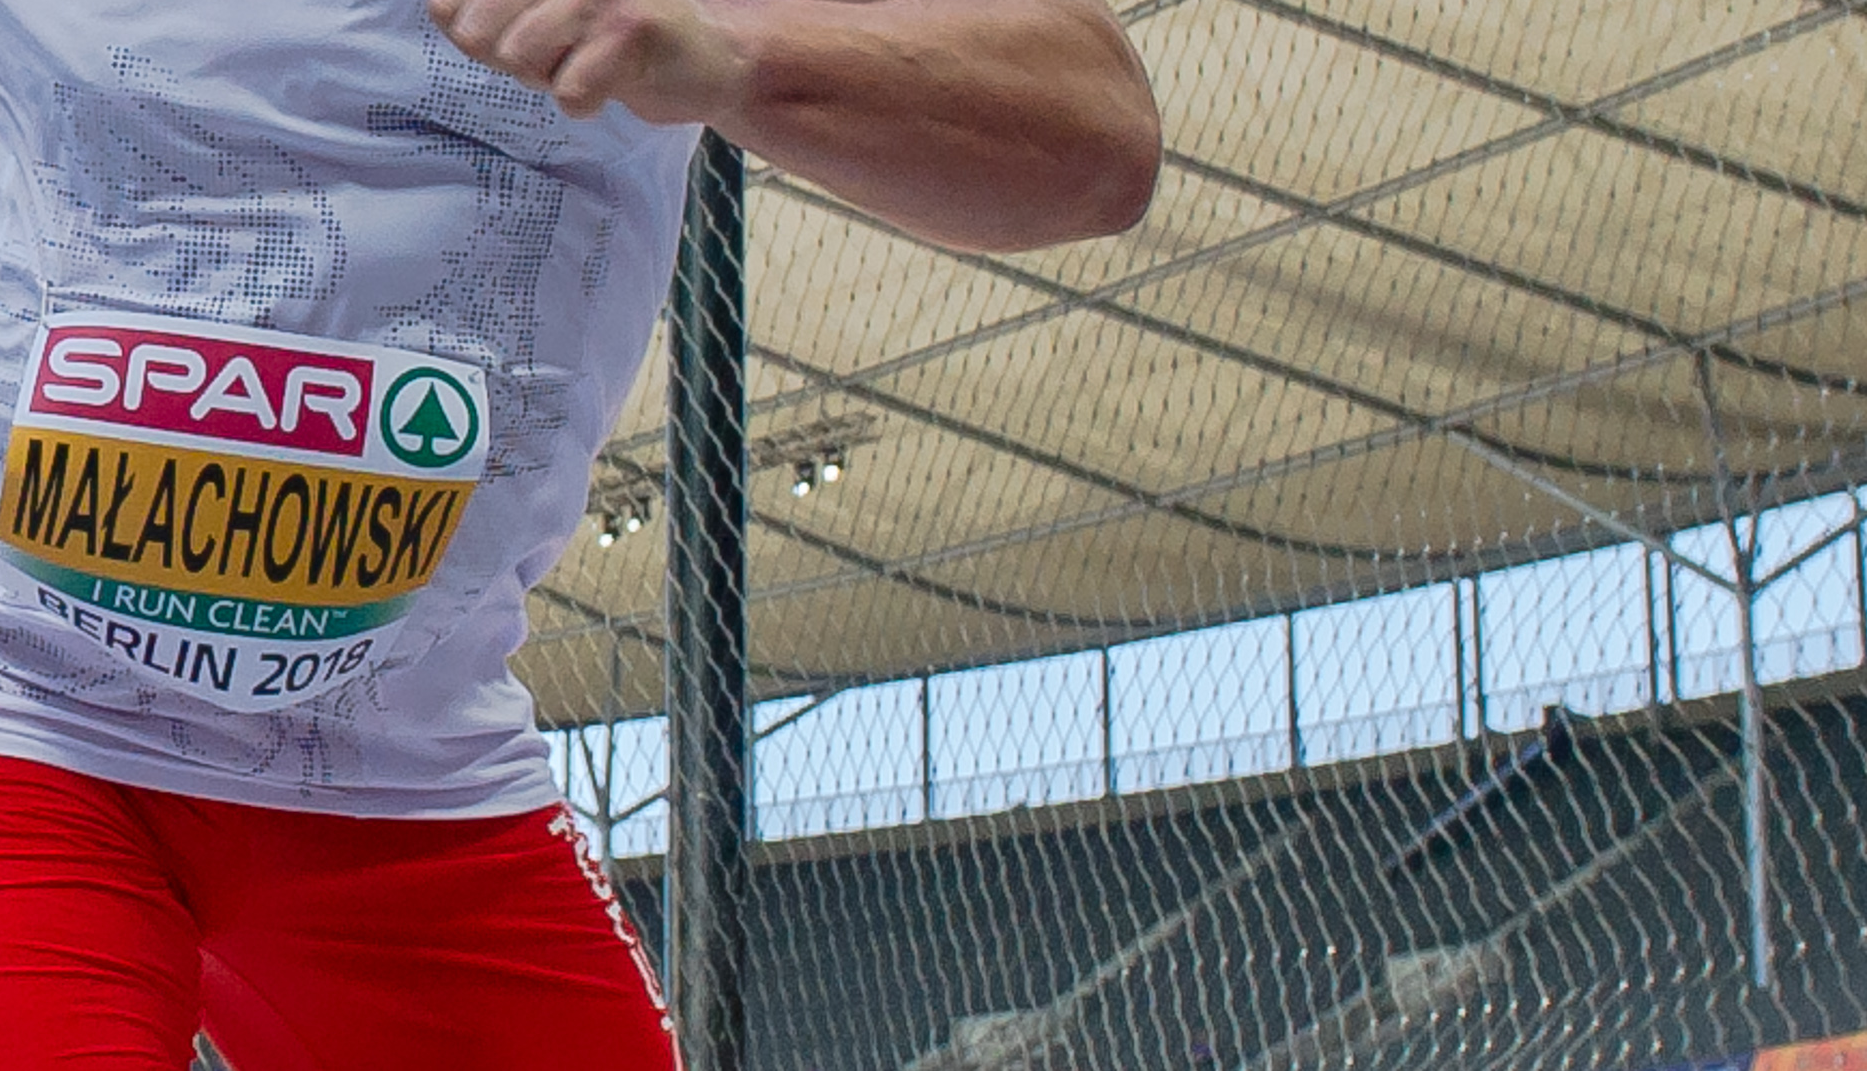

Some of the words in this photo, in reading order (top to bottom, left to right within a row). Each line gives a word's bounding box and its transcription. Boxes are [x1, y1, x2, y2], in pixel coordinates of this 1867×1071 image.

[42, 337, 364, 441] SPAR
[12, 438, 460, 590] MAŁACHOWSKI
[36, 586, 237, 692] BERLIN
[251, 638, 374, 697] 2018
[91, 580, 102, 603] I
[114, 585, 197, 623] RUN
